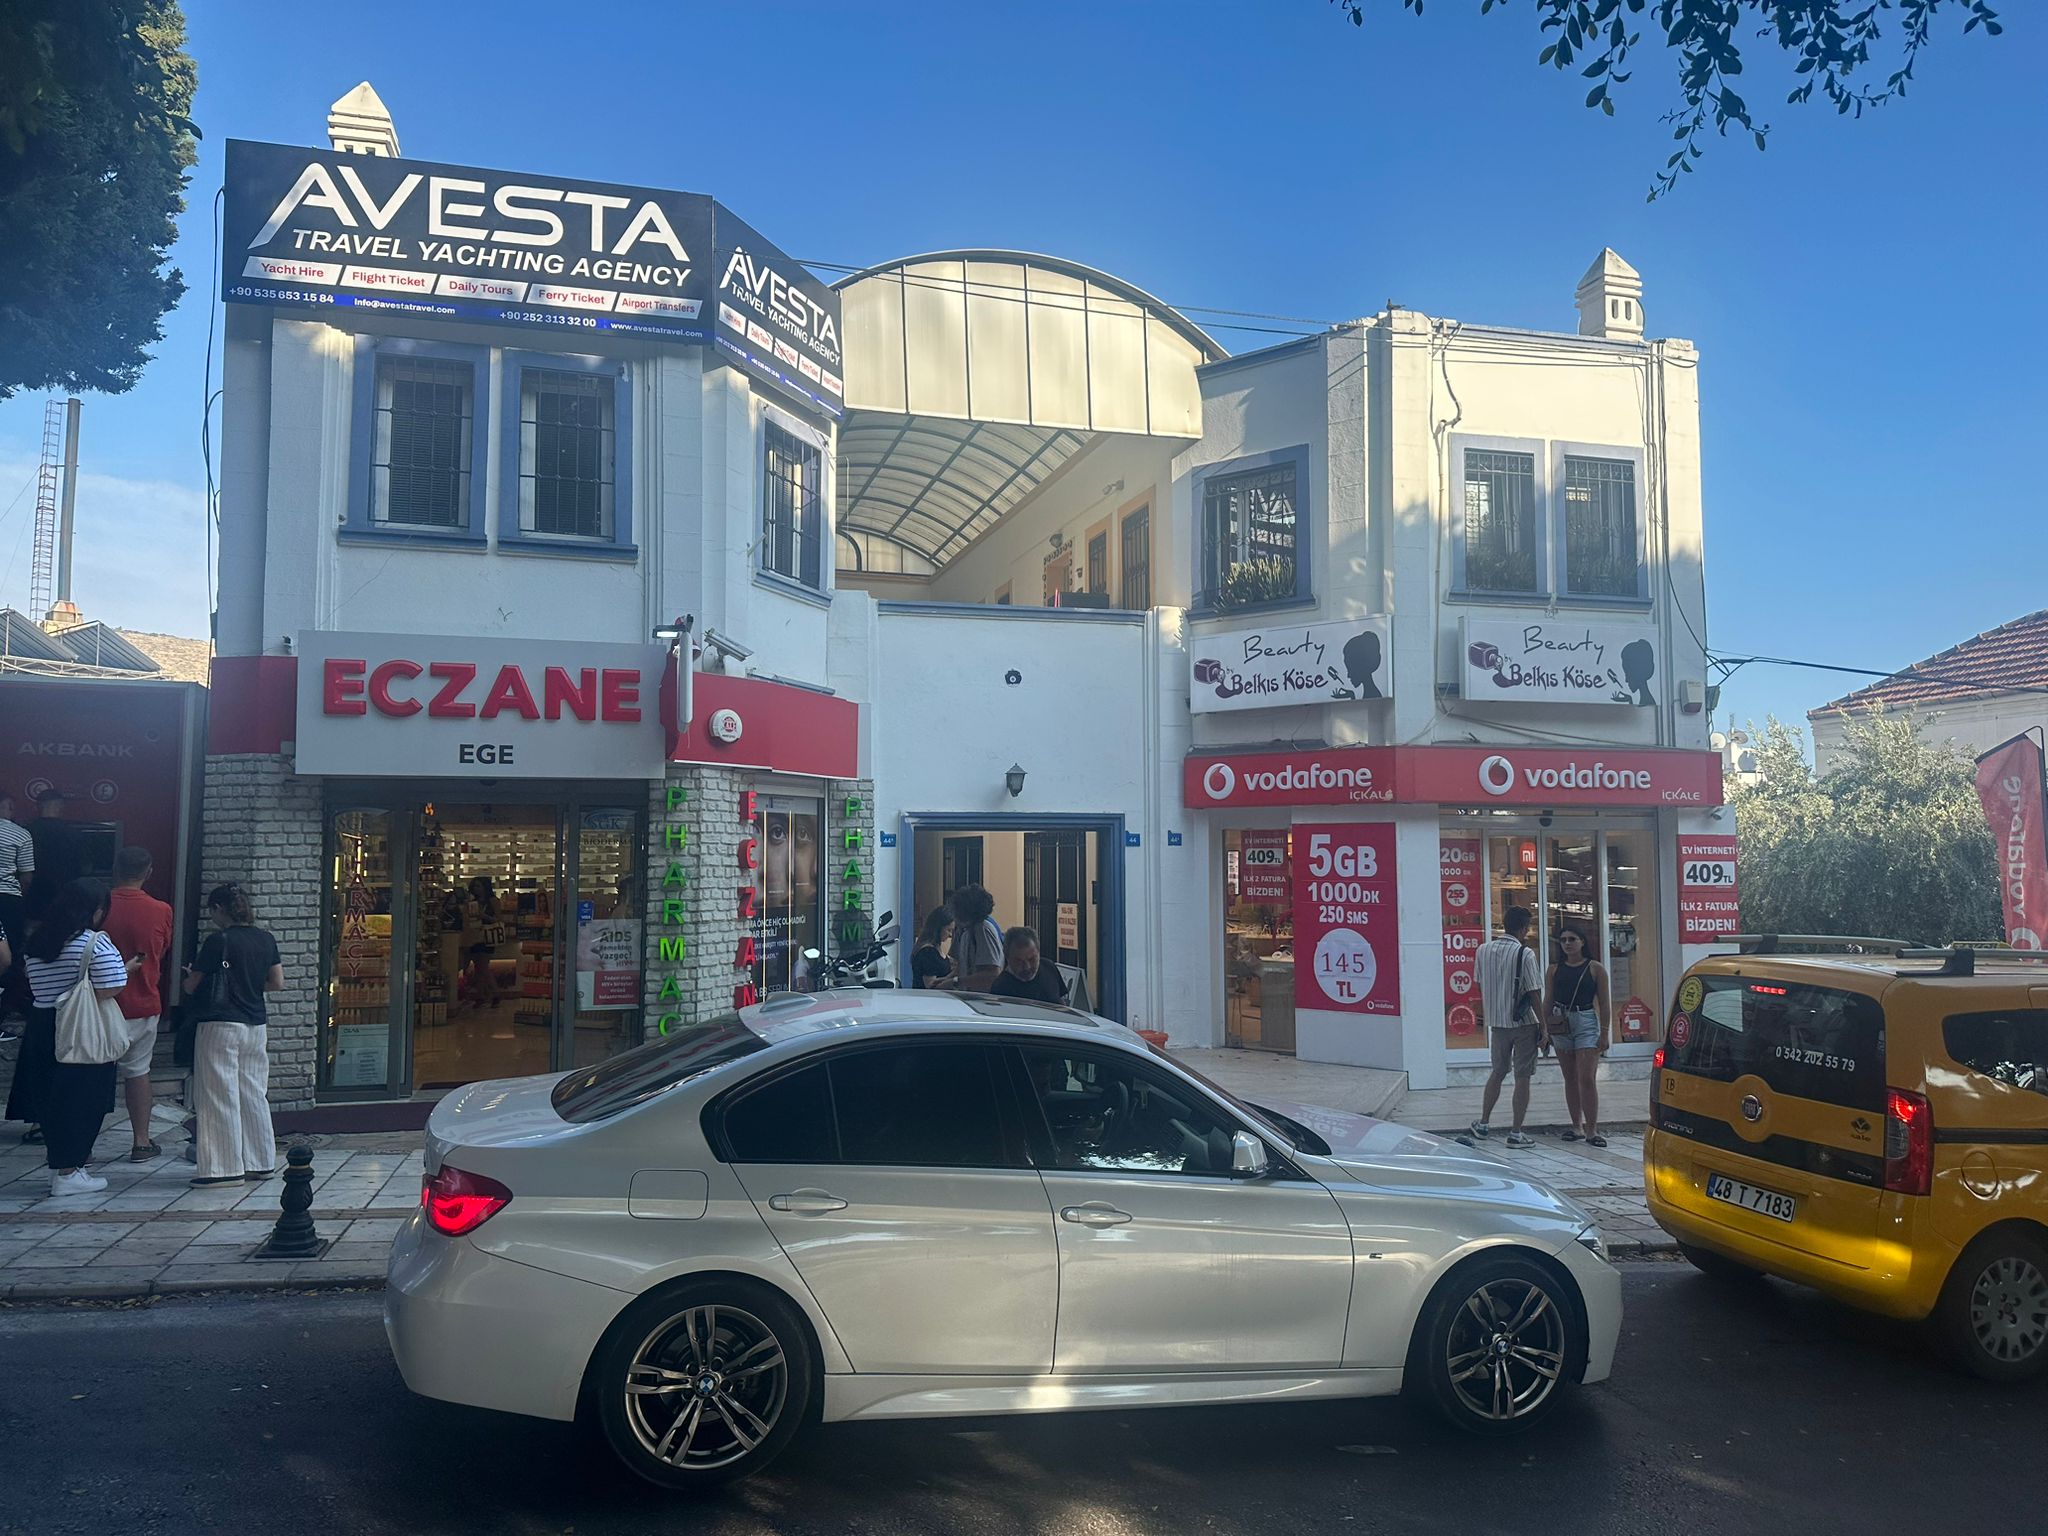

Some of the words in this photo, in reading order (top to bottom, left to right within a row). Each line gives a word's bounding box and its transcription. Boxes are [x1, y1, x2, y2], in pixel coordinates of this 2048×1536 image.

[248, 162, 691, 262] AVESTA
[293, 229, 408, 259] TRAVEL
[418, 241, 565, 274] YACHTING
[570, 258, 692, 287] AGENCY
[261, 262, 297, 276] Yacht
[299, 265, 325, 278] Hire
[352, 271, 386, 285] Flight
[388, 274, 425, 287] Ticket
[229, 287, 252, 297] +90
[253, 288, 277, 299] 535
[278, 290, 301, 301] 653
[302, 292, 318, 302] 15
[318, 293, 335, 304] 84
[449, 281, 478, 294] Daily
[481, 283, 513, 296] Tours
[538, 289, 569, 303] Ferry
[570, 292, 605, 305] Ticket
[621, 297, 653, 311] Airport
[654, 301, 696, 314] Transfers
[719, 246, 841, 354] AVESTA
[500, 311, 521, 321] +90
[522, 312, 544, 323] 252
[544, 314, 566, 325] 313
[567, 315, 582, 326] 32
[582, 317, 597, 328] 00
[731, 281, 766, 316] TRAVEL
[767, 306, 809, 345] YACHTING
[808, 337, 841, 367] AGENCY
[610, 321, 703, 338] www.avestatravel.com
[1243, 631, 1325, 665] Beauty
[1523, 626, 1604, 664] Beauty
[1282, 669, 1328, 692] Köse
[1562, 665, 1607, 688] Köse
[323, 657, 643, 723] ECZANE
[18, 742, 134, 758] AKBANK
[458, 743, 514, 765] EGE
[1243, 763, 1373, 791] vodafone
[1523, 762, 1652, 790] vodafone
[1661, 787, 1701, 801] İÇKALE
[584, 838, 632, 846] BIODERM
[1682, 846, 1693, 855] EV
[1694, 844, 1736, 855] İNTERNETİ
[1246, 887, 1284, 897] BİZDEN!
[1680, 899, 1696, 911] İLK
[1696, 902, 1703, 911] 2
[1705, 901, 1739, 911] FATURA
[1319, 905, 1345, 924] 250
[1346, 911, 1369, 925] SMS
[1686, 916, 1736, 932] BİZDEN!
[599, 931, 633, 943] AIDS
[1321, 952, 1365, 974] 145
[1453, 975, 1470, 985] 190
[1336, 981, 1356, 998] TL
[1375, 1002, 1395, 1010] vodafone
[1775, 1046, 1782, 1057] 0
[1783, 1047, 1802, 1062] 542
[1803, 1051, 1824, 1066] 202
[1825, 1055, 1839, 1069] 55
[1841, 1058, 1856, 1072] 79
[1714, 1179, 1733, 1199] 48
[1739, 1185, 1749, 1204] T
[1752, 1189, 1793, 1219] 7183
